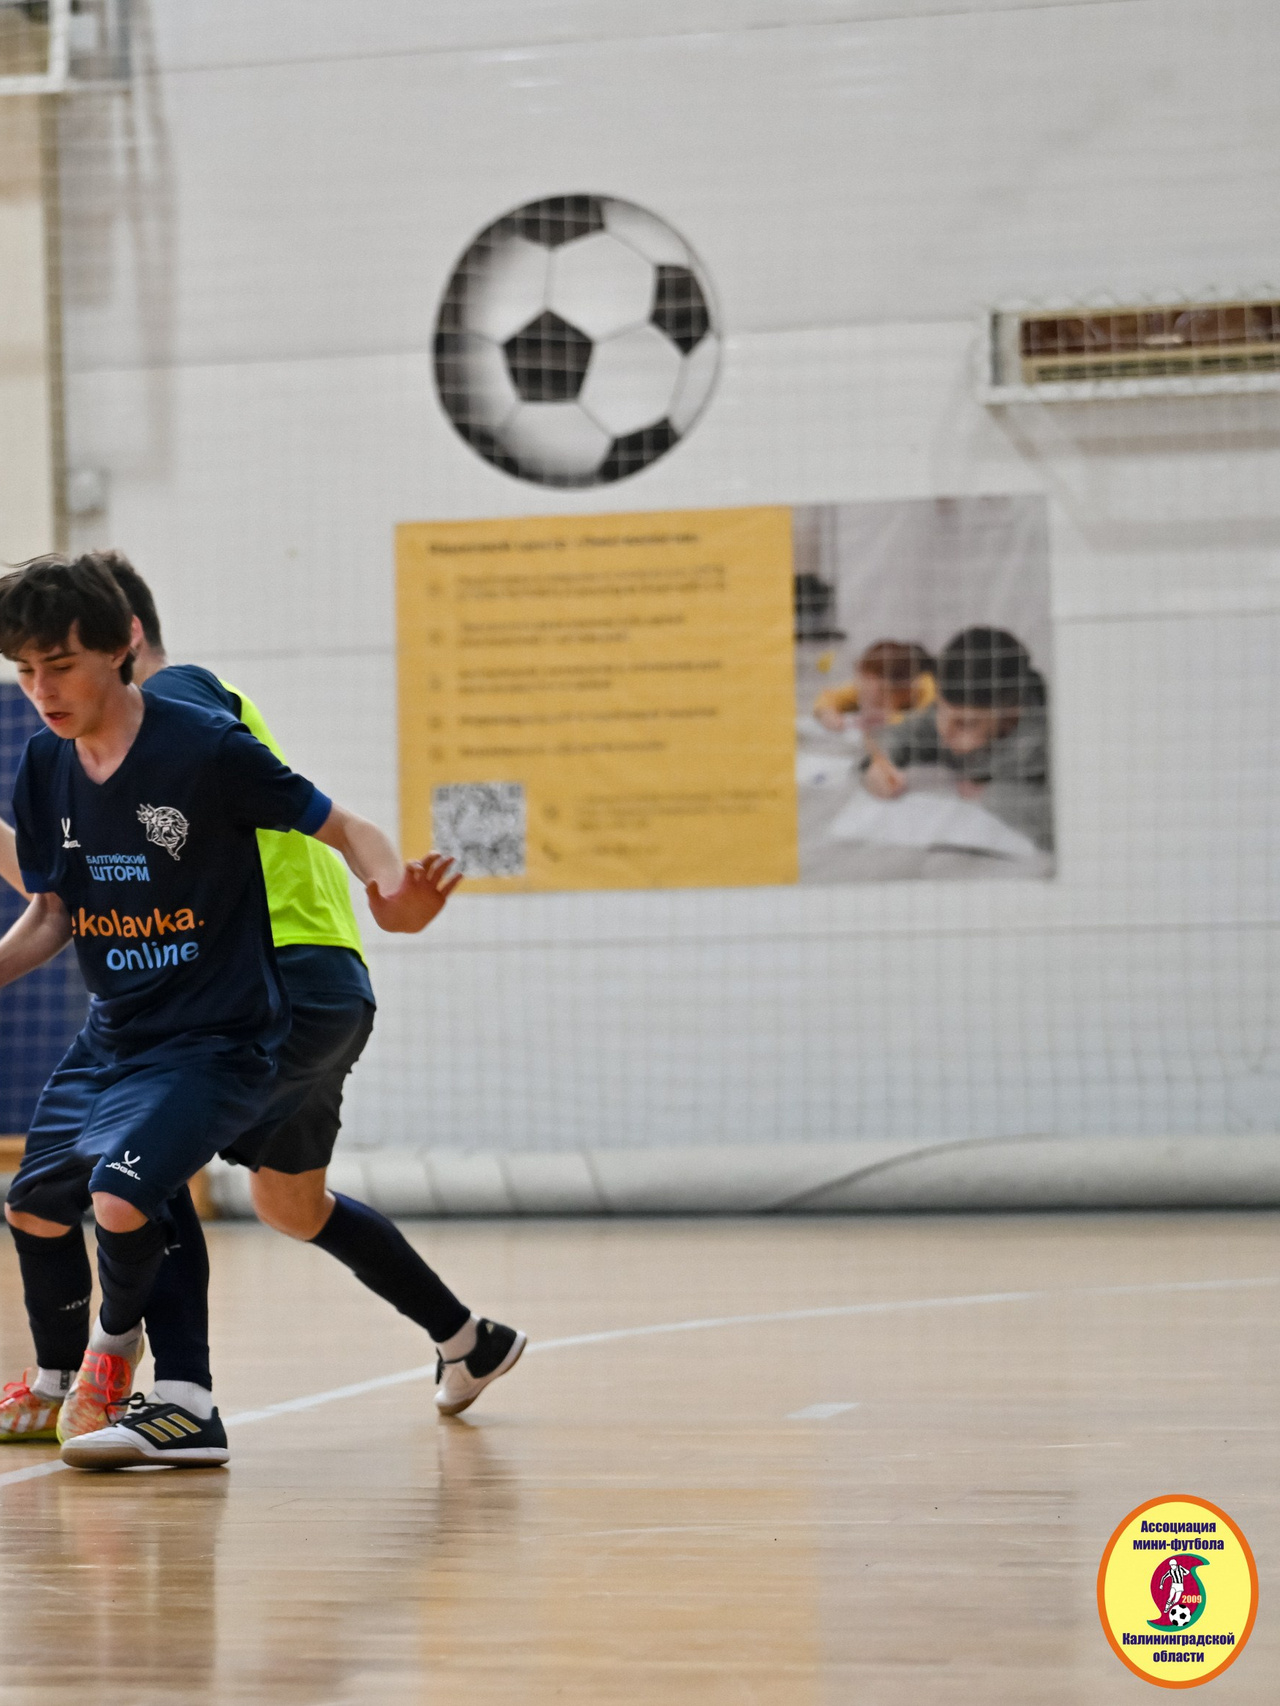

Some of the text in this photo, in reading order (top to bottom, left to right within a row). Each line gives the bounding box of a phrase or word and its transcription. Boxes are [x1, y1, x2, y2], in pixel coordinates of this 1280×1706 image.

[85, 853, 147, 865] БАЛТИЙСКИЙ
[89, 865, 151, 882] ШТОРМ
[106, 940, 200, 971] online
